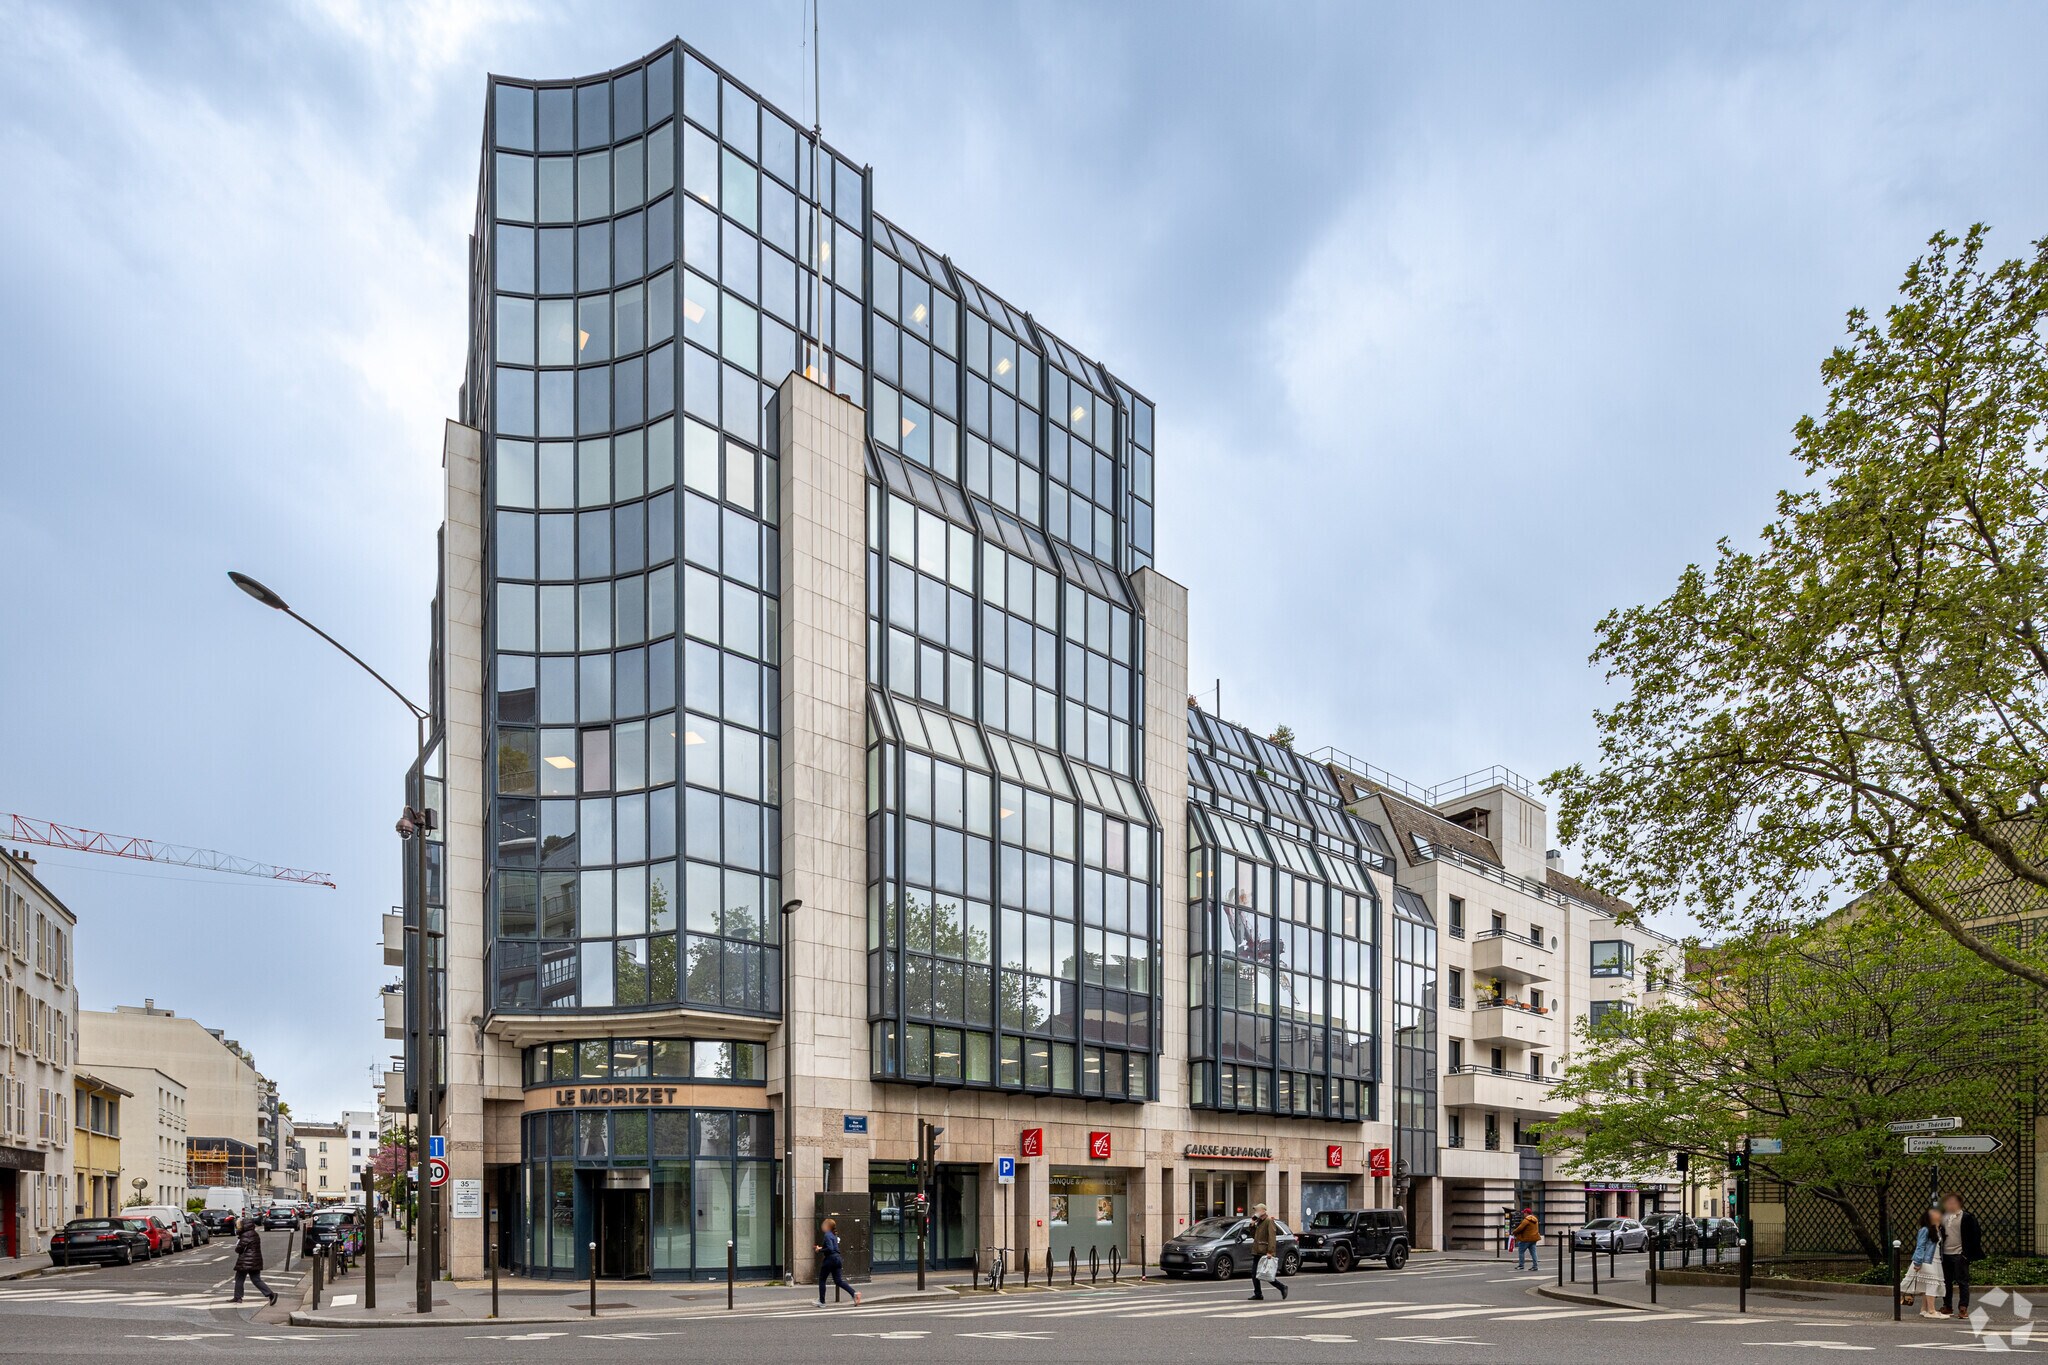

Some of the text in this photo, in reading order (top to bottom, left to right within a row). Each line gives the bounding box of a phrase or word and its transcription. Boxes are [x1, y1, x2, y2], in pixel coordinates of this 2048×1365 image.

[556, 1087, 678, 1106] LE MORIZET
[1928, 1120, 1951, 1128] Thérèse
[1184, 1144, 1220, 1156] CAISSE
[1003, 1161, 1010, 1174] P
[1049, 1178, 1075, 1186] BANQUE
